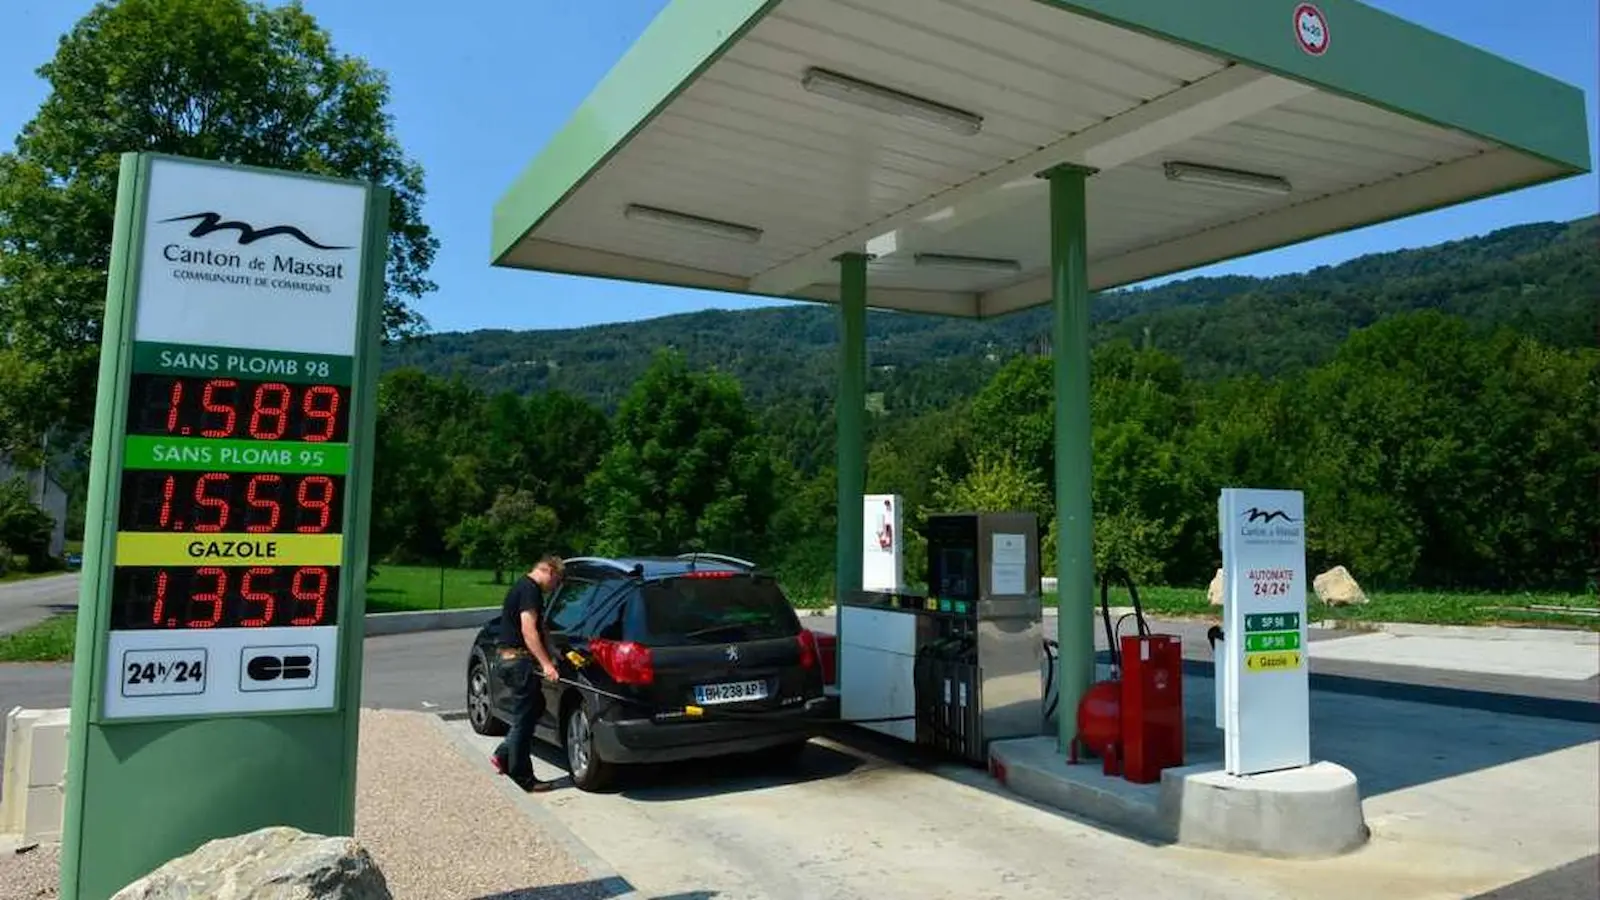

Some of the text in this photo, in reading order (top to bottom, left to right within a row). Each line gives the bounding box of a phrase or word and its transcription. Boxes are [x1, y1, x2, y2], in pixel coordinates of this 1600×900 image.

[163, 244, 344, 279] Canton de Massat
[254, 276, 269, 287] DE
[271, 278, 332, 294] COMMUNES
[160, 350, 330, 378] SANS PLOMB 98
[167, 377, 341, 443] 1.589
[152, 444, 324, 467] SANS PLOMB 95
[159, 473, 334, 532] 1.559
[188, 541, 277, 558] GAZOLE
[1248, 569, 1293, 580] AUTOMATE
[152, 567, 329, 629] 1.359
[127, 660, 203, 684] 24h/24
